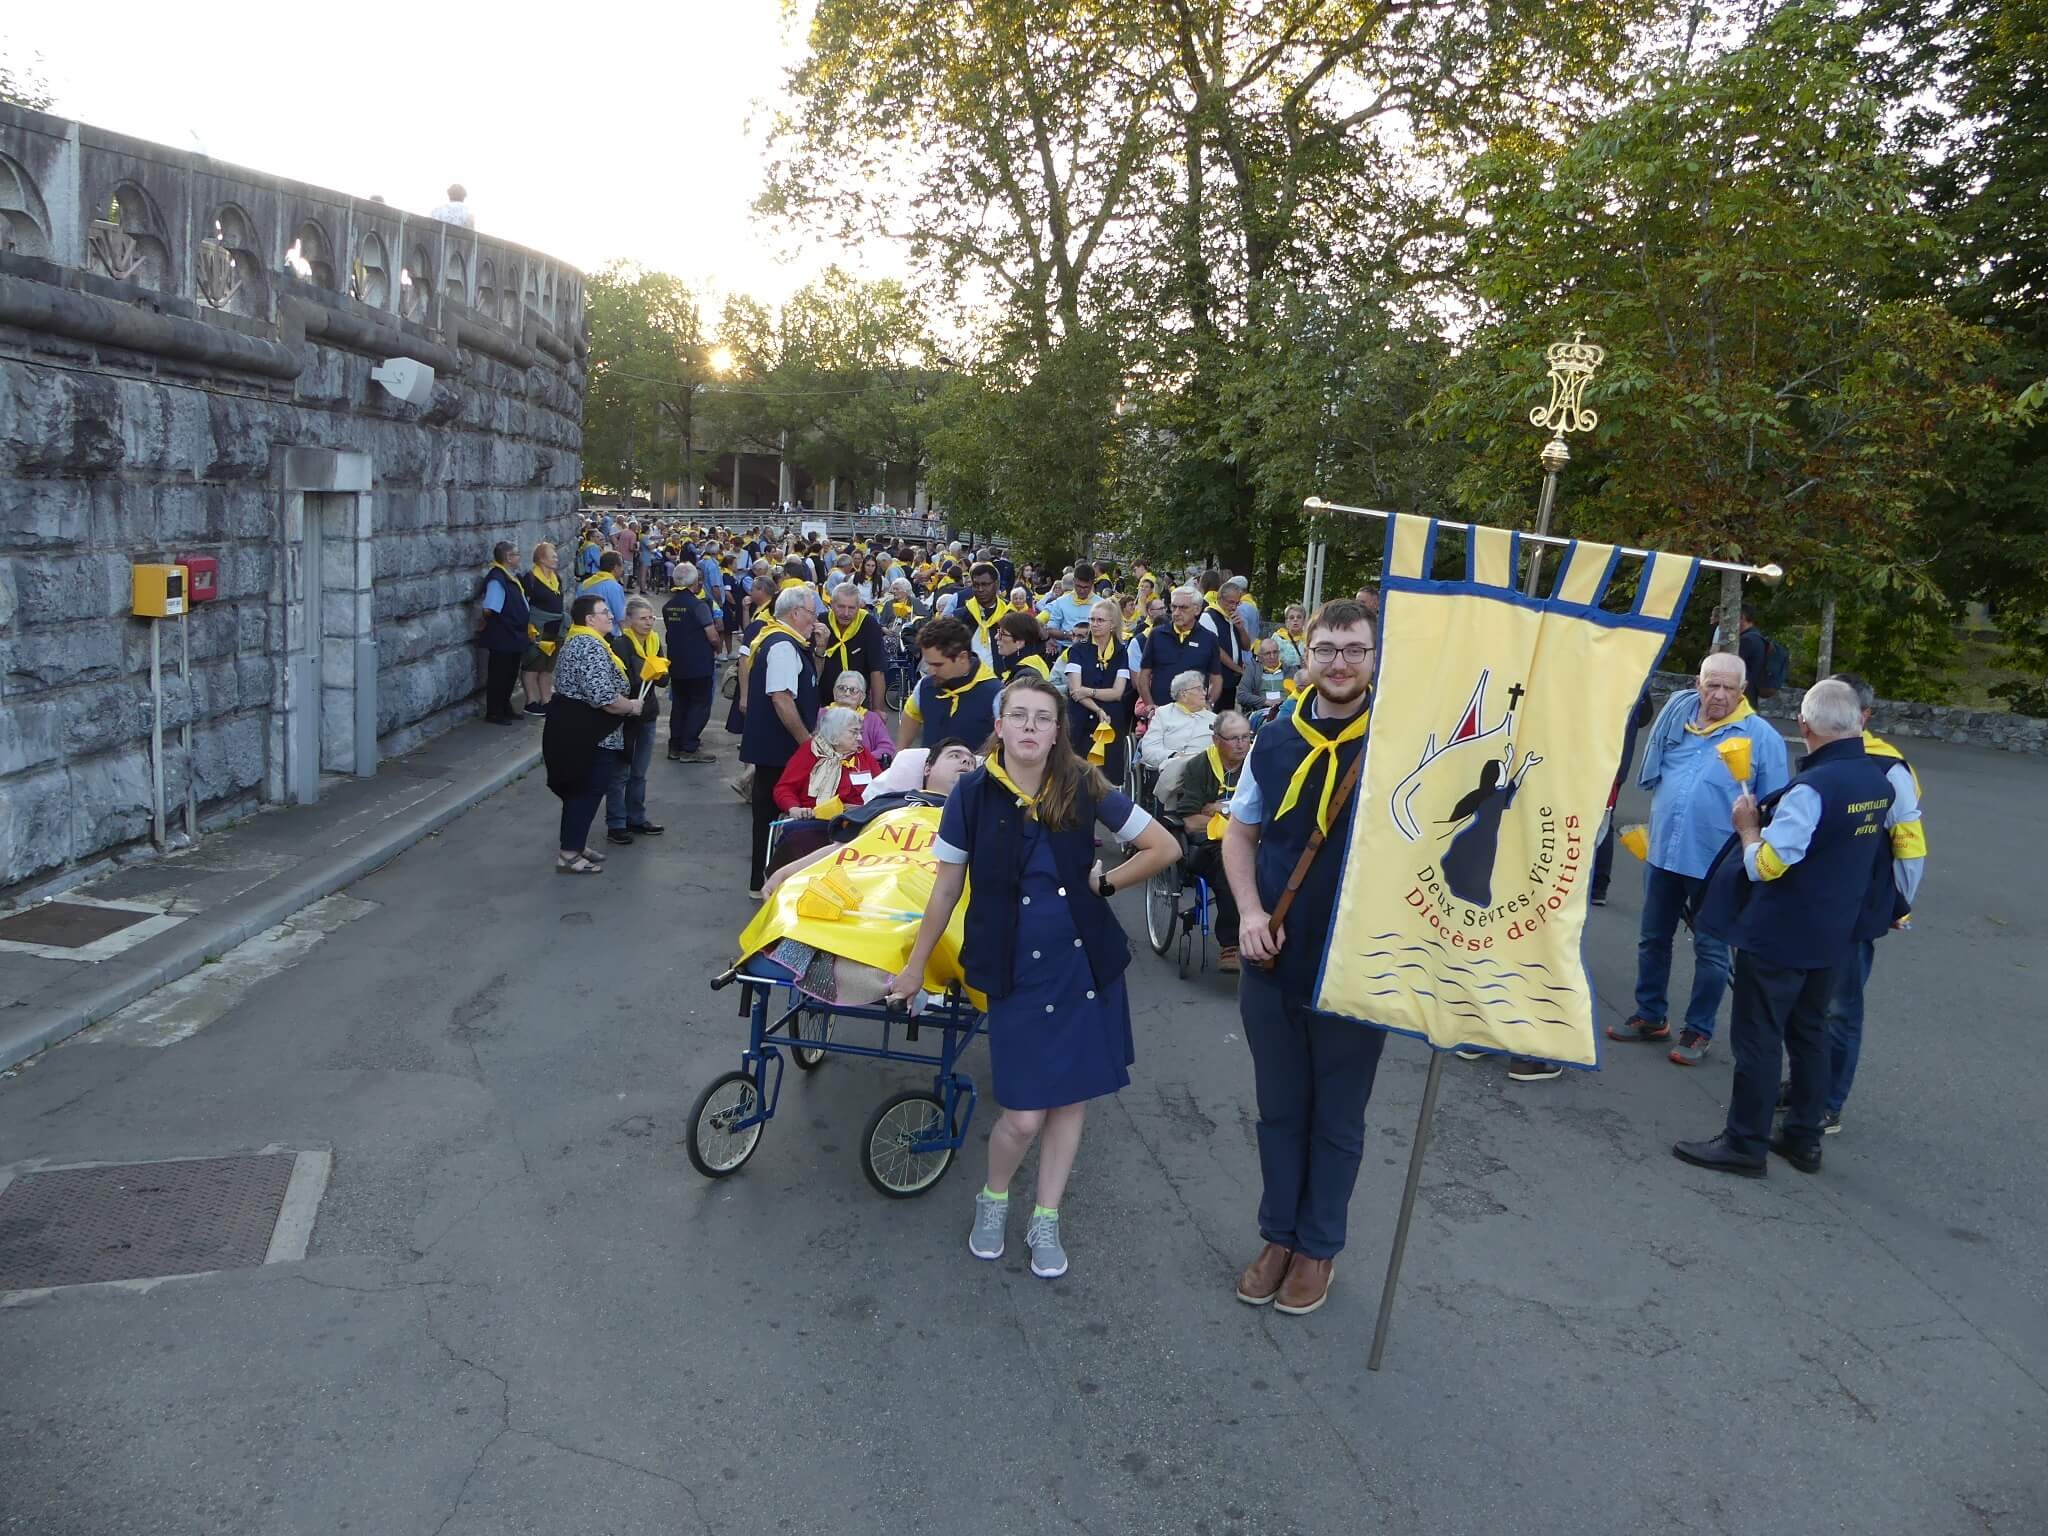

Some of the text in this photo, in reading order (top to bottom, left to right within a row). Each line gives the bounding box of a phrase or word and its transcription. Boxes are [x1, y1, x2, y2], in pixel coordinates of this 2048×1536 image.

[1404, 814, 1581, 952] Diocèse de Poitiers
[1416, 864, 1456, 918] Deux
